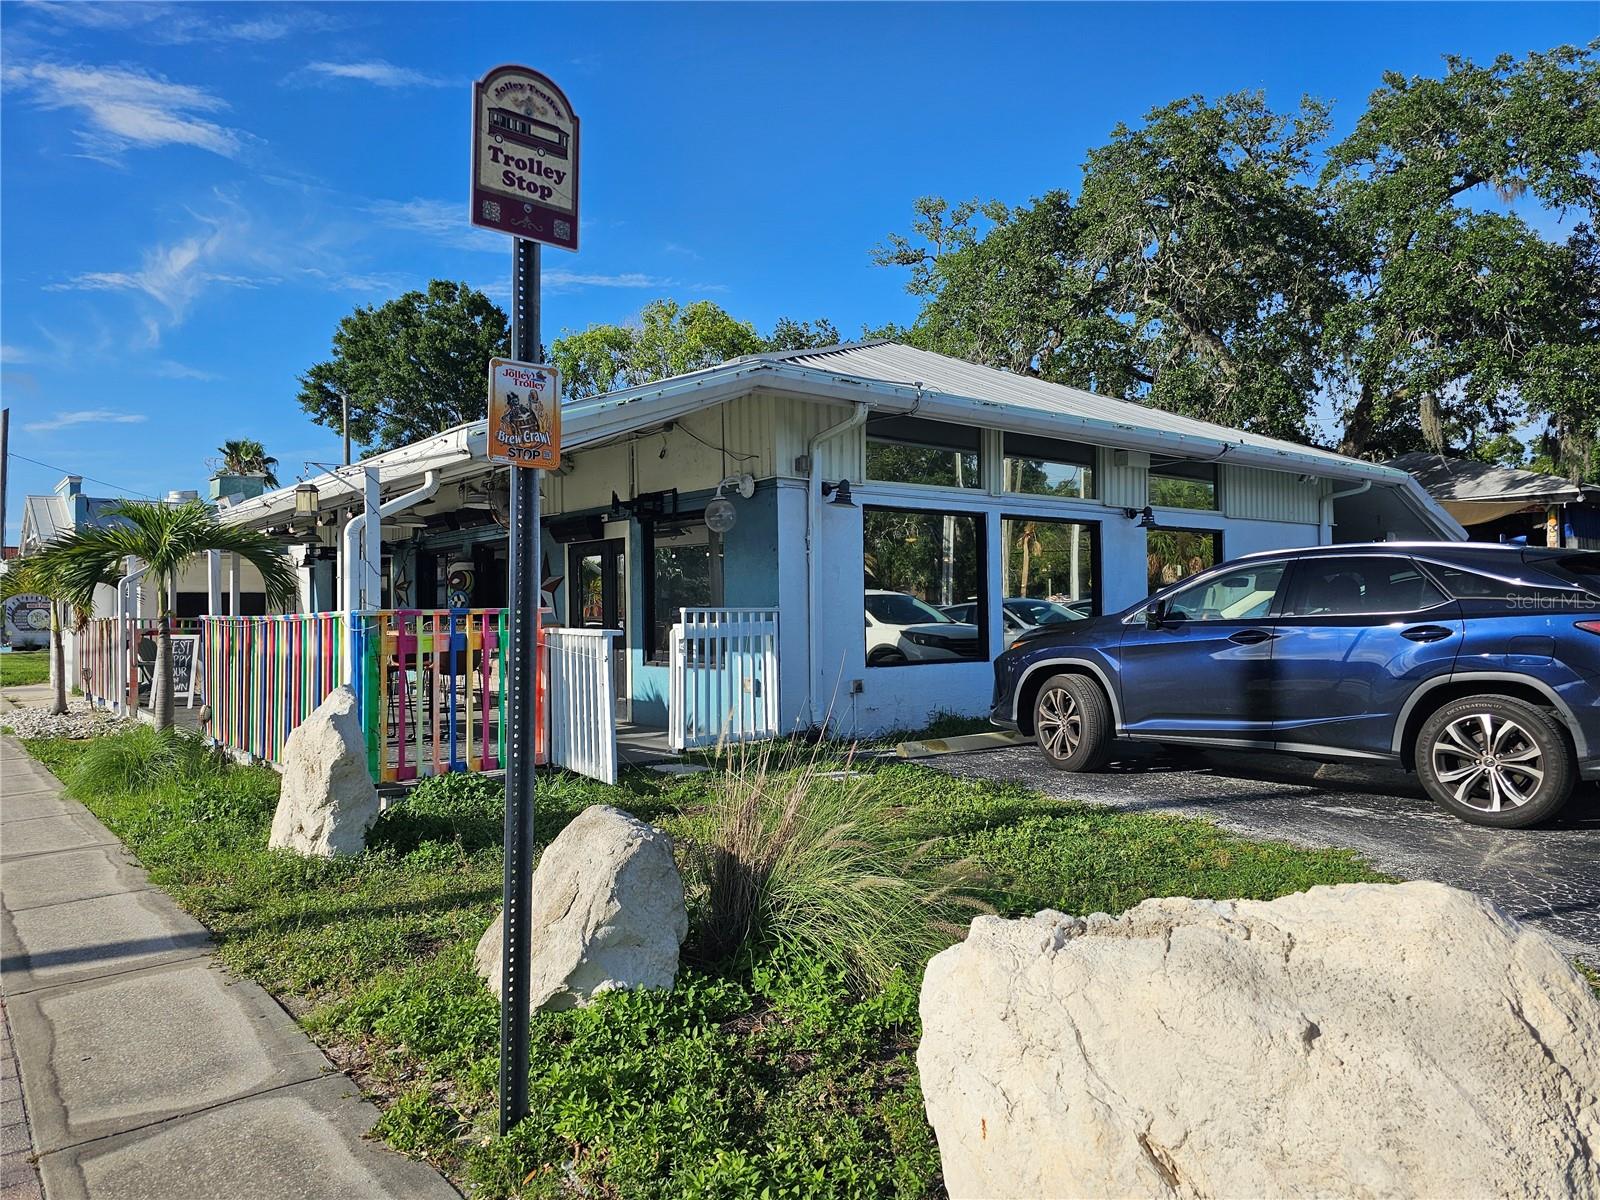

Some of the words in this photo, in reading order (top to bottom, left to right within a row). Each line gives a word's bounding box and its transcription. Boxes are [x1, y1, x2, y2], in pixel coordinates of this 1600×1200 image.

[494, 82, 525, 97] Jolley
[527, 83, 563, 117] Trolley
[488, 145, 566, 185] Trolley
[502, 170, 553, 201] Stop
[513, 378, 545, 391] Trolley
[498, 430, 521, 444] Brew
[523, 430, 551, 445] Crawl
[508, 447, 540, 460] STOP
[171, 640, 193, 654] EST
